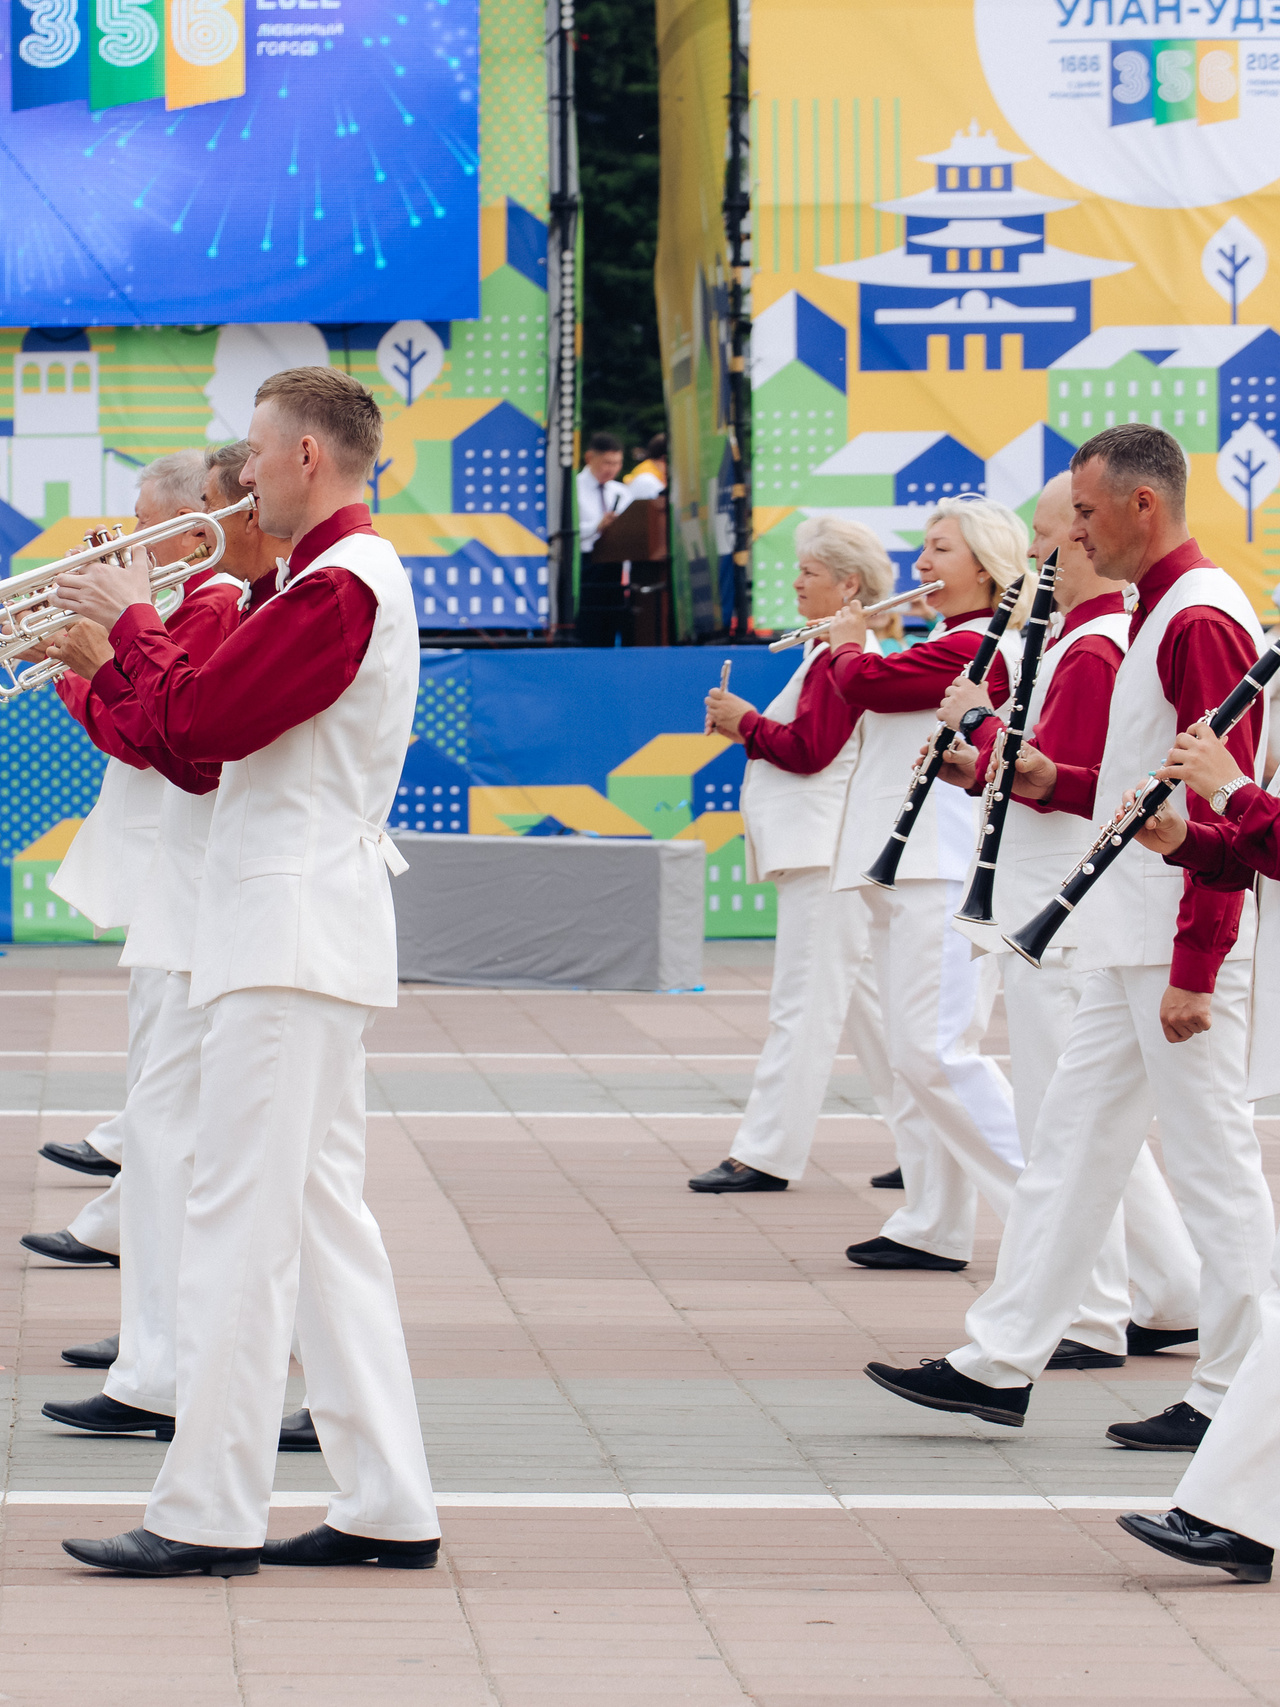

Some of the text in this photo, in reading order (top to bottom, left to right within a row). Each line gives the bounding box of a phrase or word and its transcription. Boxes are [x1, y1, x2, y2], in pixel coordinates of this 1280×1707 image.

[18, 0, 239, 69] 356
[1059, 54, 1101, 73] 1666
[1112, 50, 1237, 104] 356
